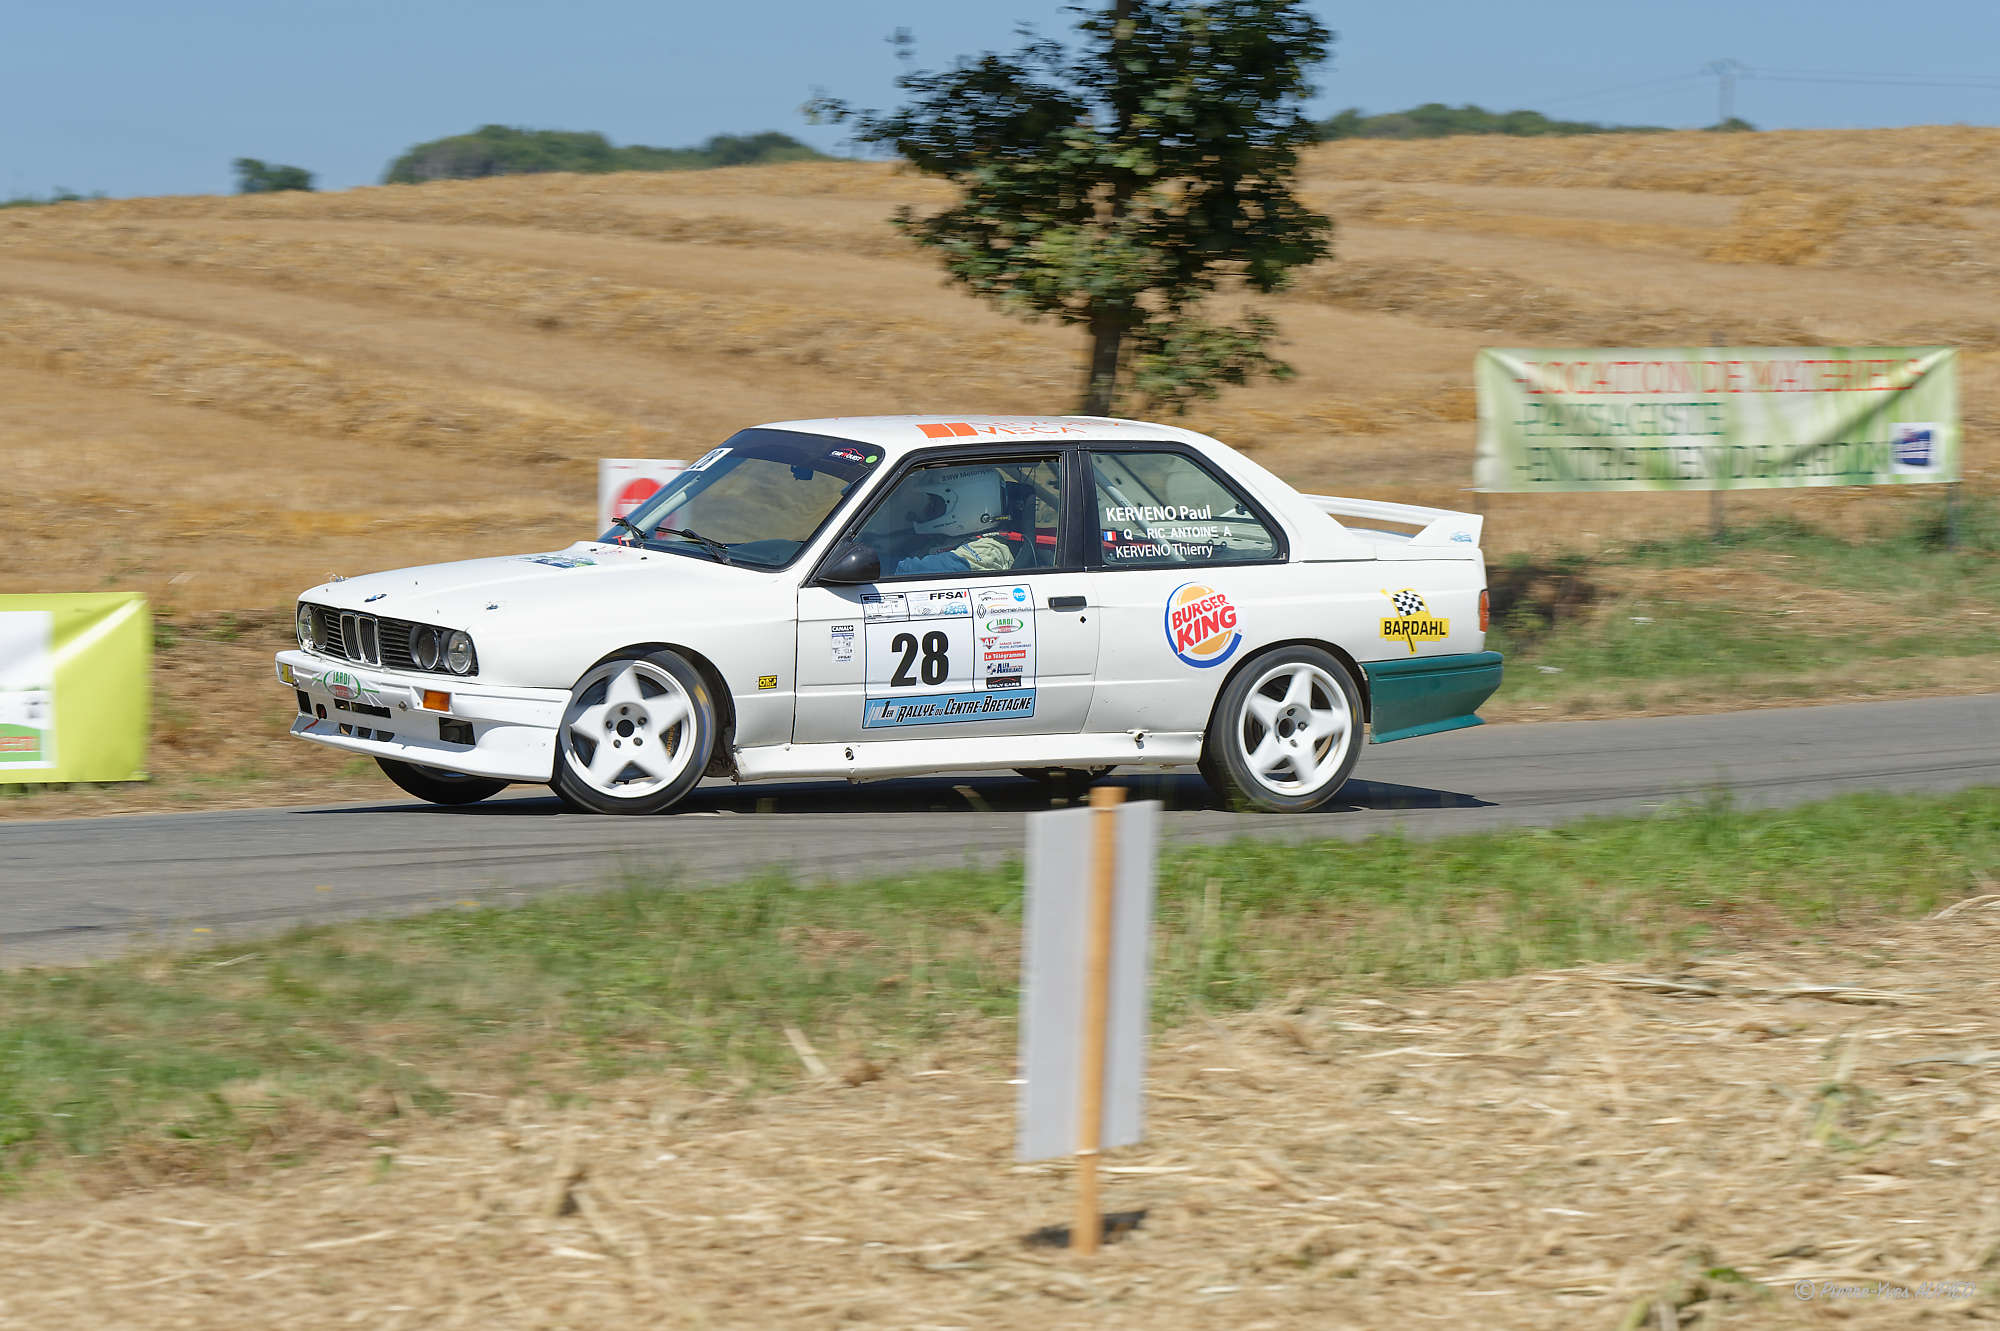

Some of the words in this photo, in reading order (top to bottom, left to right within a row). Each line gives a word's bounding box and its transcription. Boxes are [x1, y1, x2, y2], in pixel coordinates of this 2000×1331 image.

[1105, 505, 1177, 522] KERVENO
[1179, 504, 1212, 520] Paul
[1123, 528, 1133, 541] Q
[1169, 526, 1219, 539] ANTOINE
[1115, 545, 1171, 559] KERVENO
[1172, 543, 1213, 559] Thierry
[929, 591, 964, 601] FFSA
[1171, 593, 1230, 630] BURGER
[1176, 605, 1237, 653] KING
[1383, 620, 1447, 636] BARDAHL
[984, 638, 996, 646] AD
[890, 630, 949, 688] 28
[895, 703, 936, 722] RALLYE
[944, 696, 1032, 716] CENTRE-BRETAGNE
